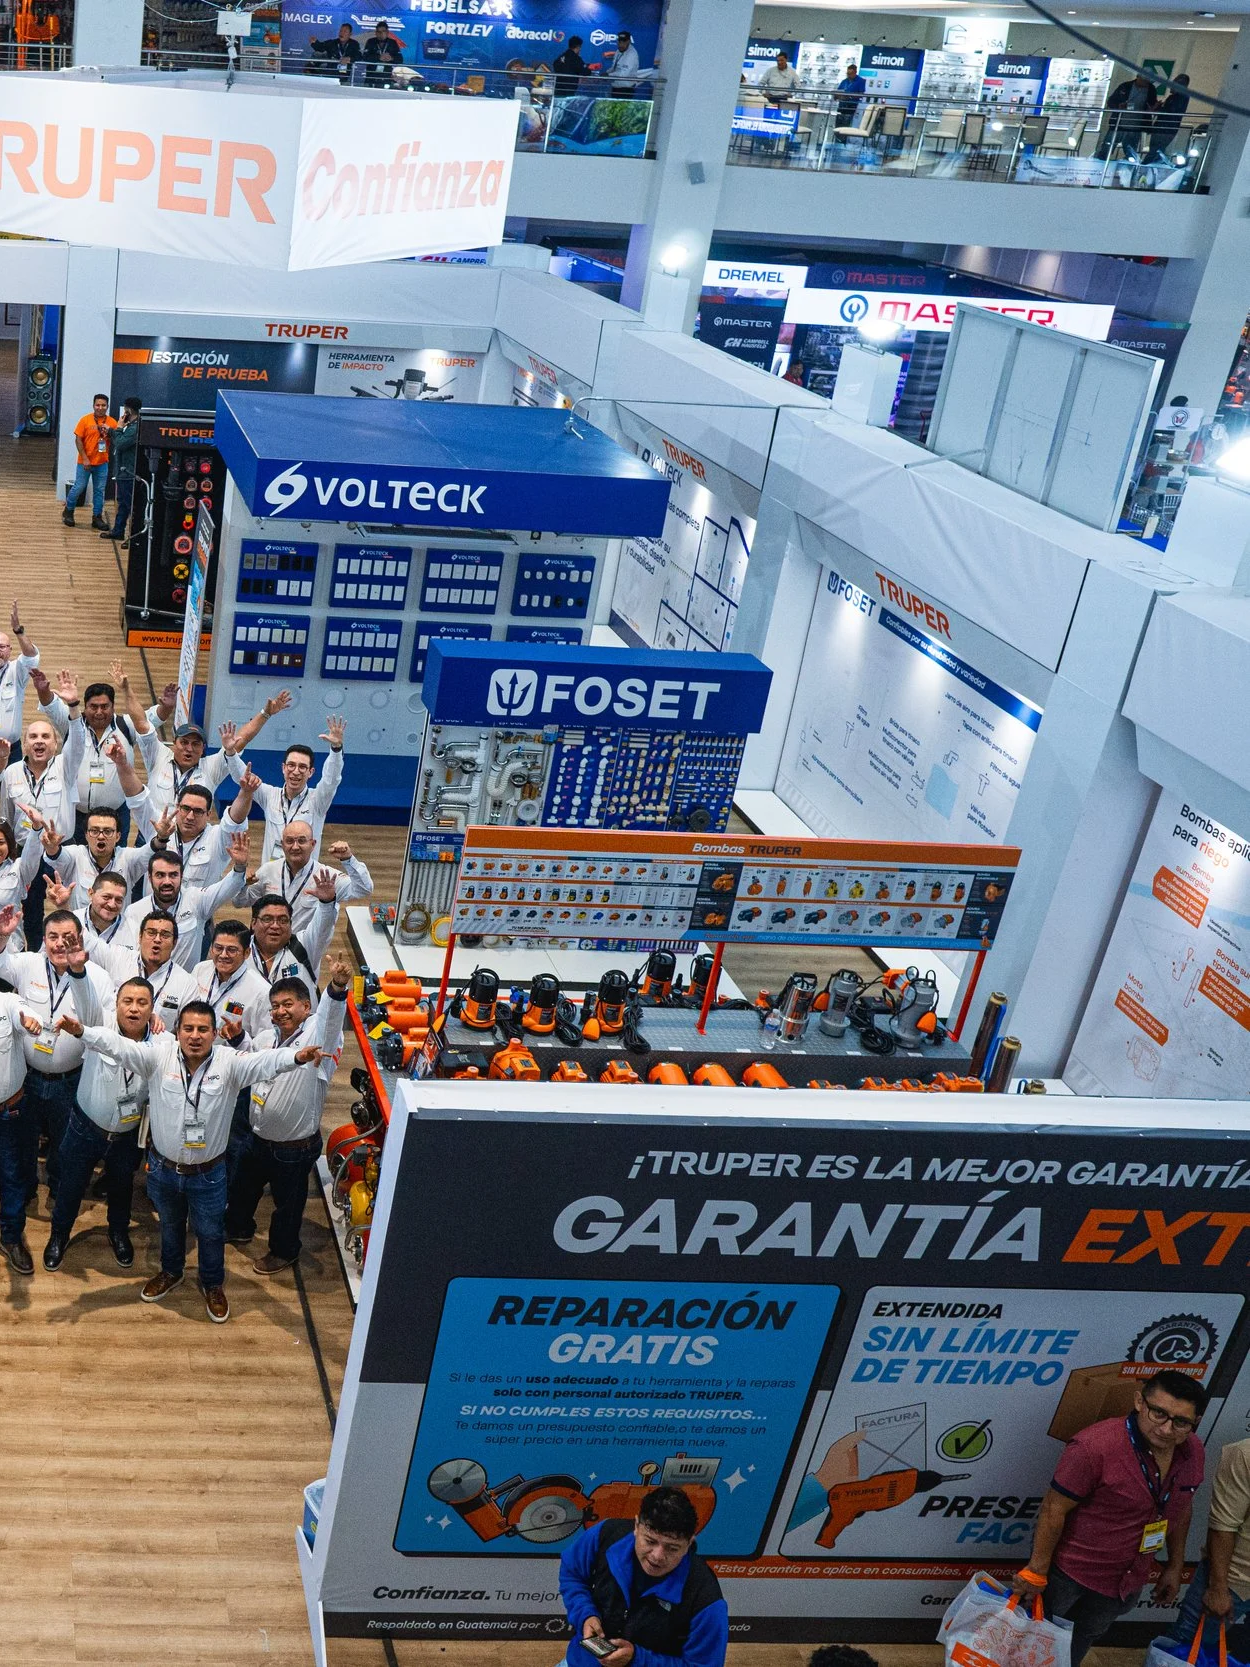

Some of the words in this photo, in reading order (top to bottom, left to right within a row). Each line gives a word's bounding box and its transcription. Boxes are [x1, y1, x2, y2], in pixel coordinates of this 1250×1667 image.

[426, 21, 494, 37] FORTLEV
[505, 26, 552, 41] abracol
[747, 44, 780, 57] simon
[871, 52, 904, 66] simon
[997, 60, 1030, 75] simon
[302, 141, 505, 222] Confianza
[718, 268, 784, 283] DREMEL
[847, 271, 925, 285] MASTER
[723, 318, 772, 327] MASTER
[878, 301, 1055, 329] MASR
[265, 323, 348, 340] TRUPER
[1120, 340, 1166, 349] MASTER
[152, 349, 229, 365] ESTACIÓN
[328, 352, 395, 363] HERRAMIENTA
[183, 366, 201, 379] DE
[204, 367, 268, 382] PRUEBA
[327, 361, 340, 370] DE
[342, 361, 384, 371] IMPACTO
[528, 355, 559, 385] TRUPER
[662, 438, 707, 482] TRUPER
[314, 476, 488, 514] VOLTECK
[676, 504, 700, 531] completa
[629, 547, 655, 575] durabilidad
[836, 580, 877, 617] FOSET
[875, 571, 952, 640] TRUPER
[446, 626, 469, 634] VOLTECK
[886, 615, 911, 640] Confiables
[960, 665, 986, 690] variedad
[540, 674, 721, 720] FOSET
[1180, 803, 1226, 843] Bombas
[692, 843, 745, 854] Bombas
[749, 845, 801, 856] TRUPER
[1173, 823, 1199, 849] para
[1199, 840, 1229, 869] riego
[1191, 862, 1214, 883] Bomba
[1216, 948, 1239, 971] Bomba
[1212, 959, 1225, 973] tipo
[1226, 969, 1241, 985] bala
[628, 1150, 801, 1179] ¡TRUPER
[806, 1154, 858, 1180] ES
[863, 1156, 913, 1181] LA
[922, 1158, 1061, 1185] MEJOR
[553, 1190, 1042, 1261] GARANTÍA
[1061, 1208, 1250, 1266] EXT
[487, 1291, 798, 1330] REPARACIÓN
[872, 1301, 1003, 1319] EXTENDIDA
[863, 1325, 937, 1353] SIN
[938, 1319, 1080, 1355] LÍMITE
[548, 1333, 719, 1366] GRATIS
[851, 1358, 914, 1383] DE
[917, 1359, 1064, 1387] TIEMPO
[1122, 1366, 1135, 1375] SIN
[449, 1373, 461, 1382] Si
[465, 1373, 476, 1382] le
[479, 1373, 502, 1383] das
[507, 1375, 522, 1383] un
[526, 1376, 550, 1384] uso
[553, 1375, 618, 1385] adecuado
[633, 1376, 645, 1385] tu
[649, 1376, 722, 1387] herramienta
[725, 1380, 733, 1389] y
[736, 1378, 746, 1387] la
[750, 1379, 796, 1389] reparas
[493, 1388, 522, 1396] solo
[525, 1389, 549, 1397] con
[552, 1389, 611, 1399] personal
[614, 1390, 686, 1399] autorizado
[689, 1391, 745, 1400] TRUPER.
[460, 1405, 477, 1415] SI
[480, 1405, 506, 1416] NO
[509, 1406, 591, 1417] CUMPLES
[594, 1407, 649, 1418] ESTOS
[652, 1408, 767, 1420] REQUISITOS...
[861, 1411, 921, 1430] FACTURA
[455, 1421, 469, 1430] Te
[472, 1421, 514, 1430] damos
[537, 1422, 615, 1433] presupuesto
[691, 1424, 701, 1433] te
[705, 1424, 747, 1434] damos
[751, 1427, 766, 1435] un
[485, 1435, 520, 1445] súper
[523, 1435, 563, 1446] precio
[612, 1437, 684, 1447] herramienta
[688, 1439, 727, 1447] nueva.
[845, 1486, 884, 1497] TRUPER
[918, 1496, 1044, 1518] PRESE
[747, 1564, 801, 1576] garantía
[804, 1566, 819, 1575] no
[823, 1564, 861, 1577] aplica
[864, 1567, 878, 1575] en
[881, 1565, 962, 1577] consumibles,
[372, 1586, 490, 1600] Confianza.
[496, 1590, 511, 1600] Tu
[516, 1590, 563, 1602] mejor
[367, 1620, 436, 1631] Respaldado
[438, 1622, 453, 1630] en
[456, 1620, 518, 1630] Guatemala
[519, 1623, 541, 1632] por
